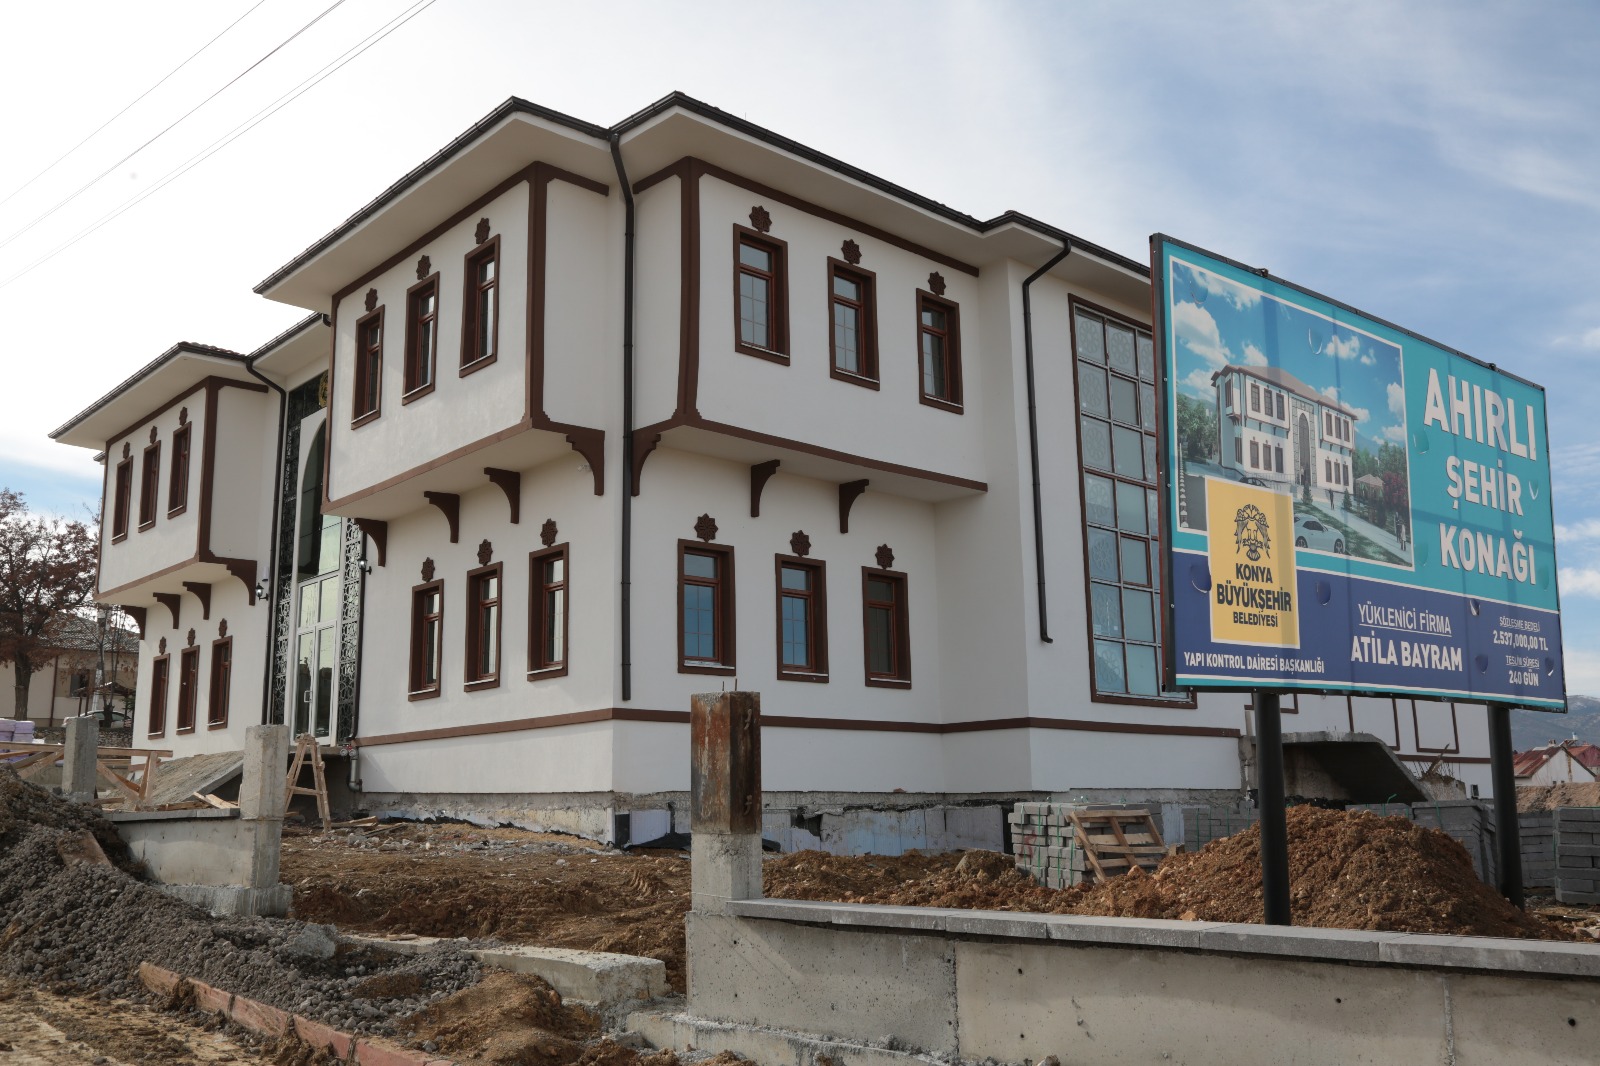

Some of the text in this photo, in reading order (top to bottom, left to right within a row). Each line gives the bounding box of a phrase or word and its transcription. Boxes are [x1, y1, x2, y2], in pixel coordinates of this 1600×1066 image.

[1423, 367, 1537, 461] AHIRLI
[1446, 455, 1524, 517] ŞEHİR
[1439, 522, 1537, 585] KONAĞI
[1235, 563, 1273, 584] KONYA
[1216, 580, 1292, 612] BÜYÜKŞEHİR
[1233, 611, 1278, 628] BELEDİYESİ
[1358, 600, 1452, 634] YÜKLENİCİ FİRMA
[1350, 630, 1463, 672] ATİLA BAYRAM
[1538, 637, 1549, 651] TL
[1184, 651, 1325, 675] YAPI KONTROL DAİRESİ BAŞKANLIĞI
[1508, 669, 1539, 687] 240 GÜN
